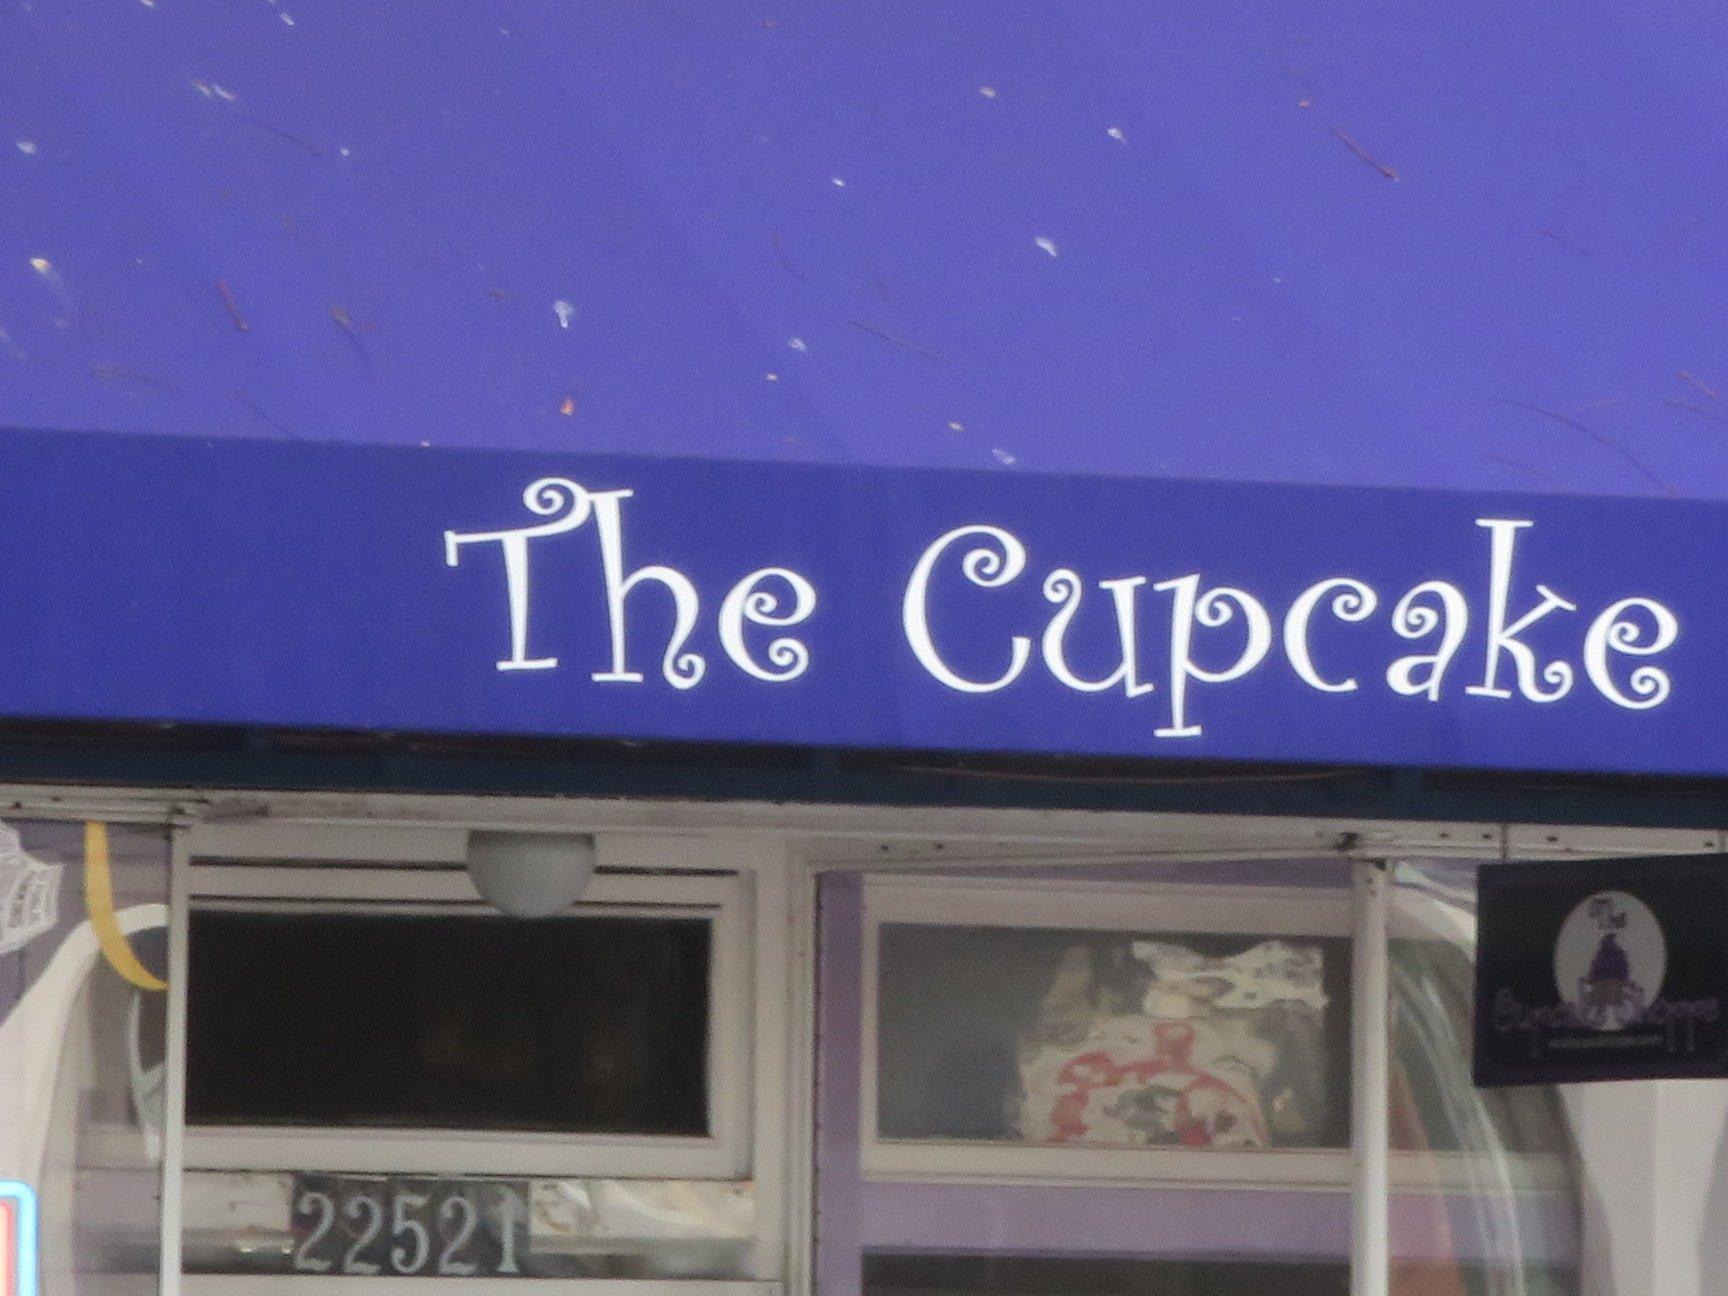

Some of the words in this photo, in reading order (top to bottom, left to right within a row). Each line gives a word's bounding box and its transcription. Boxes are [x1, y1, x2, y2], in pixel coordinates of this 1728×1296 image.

[444, 477, 817, 690] The
[902, 518, 1679, 738] Cupcake
[294, 1187, 520, 1275] 22521
